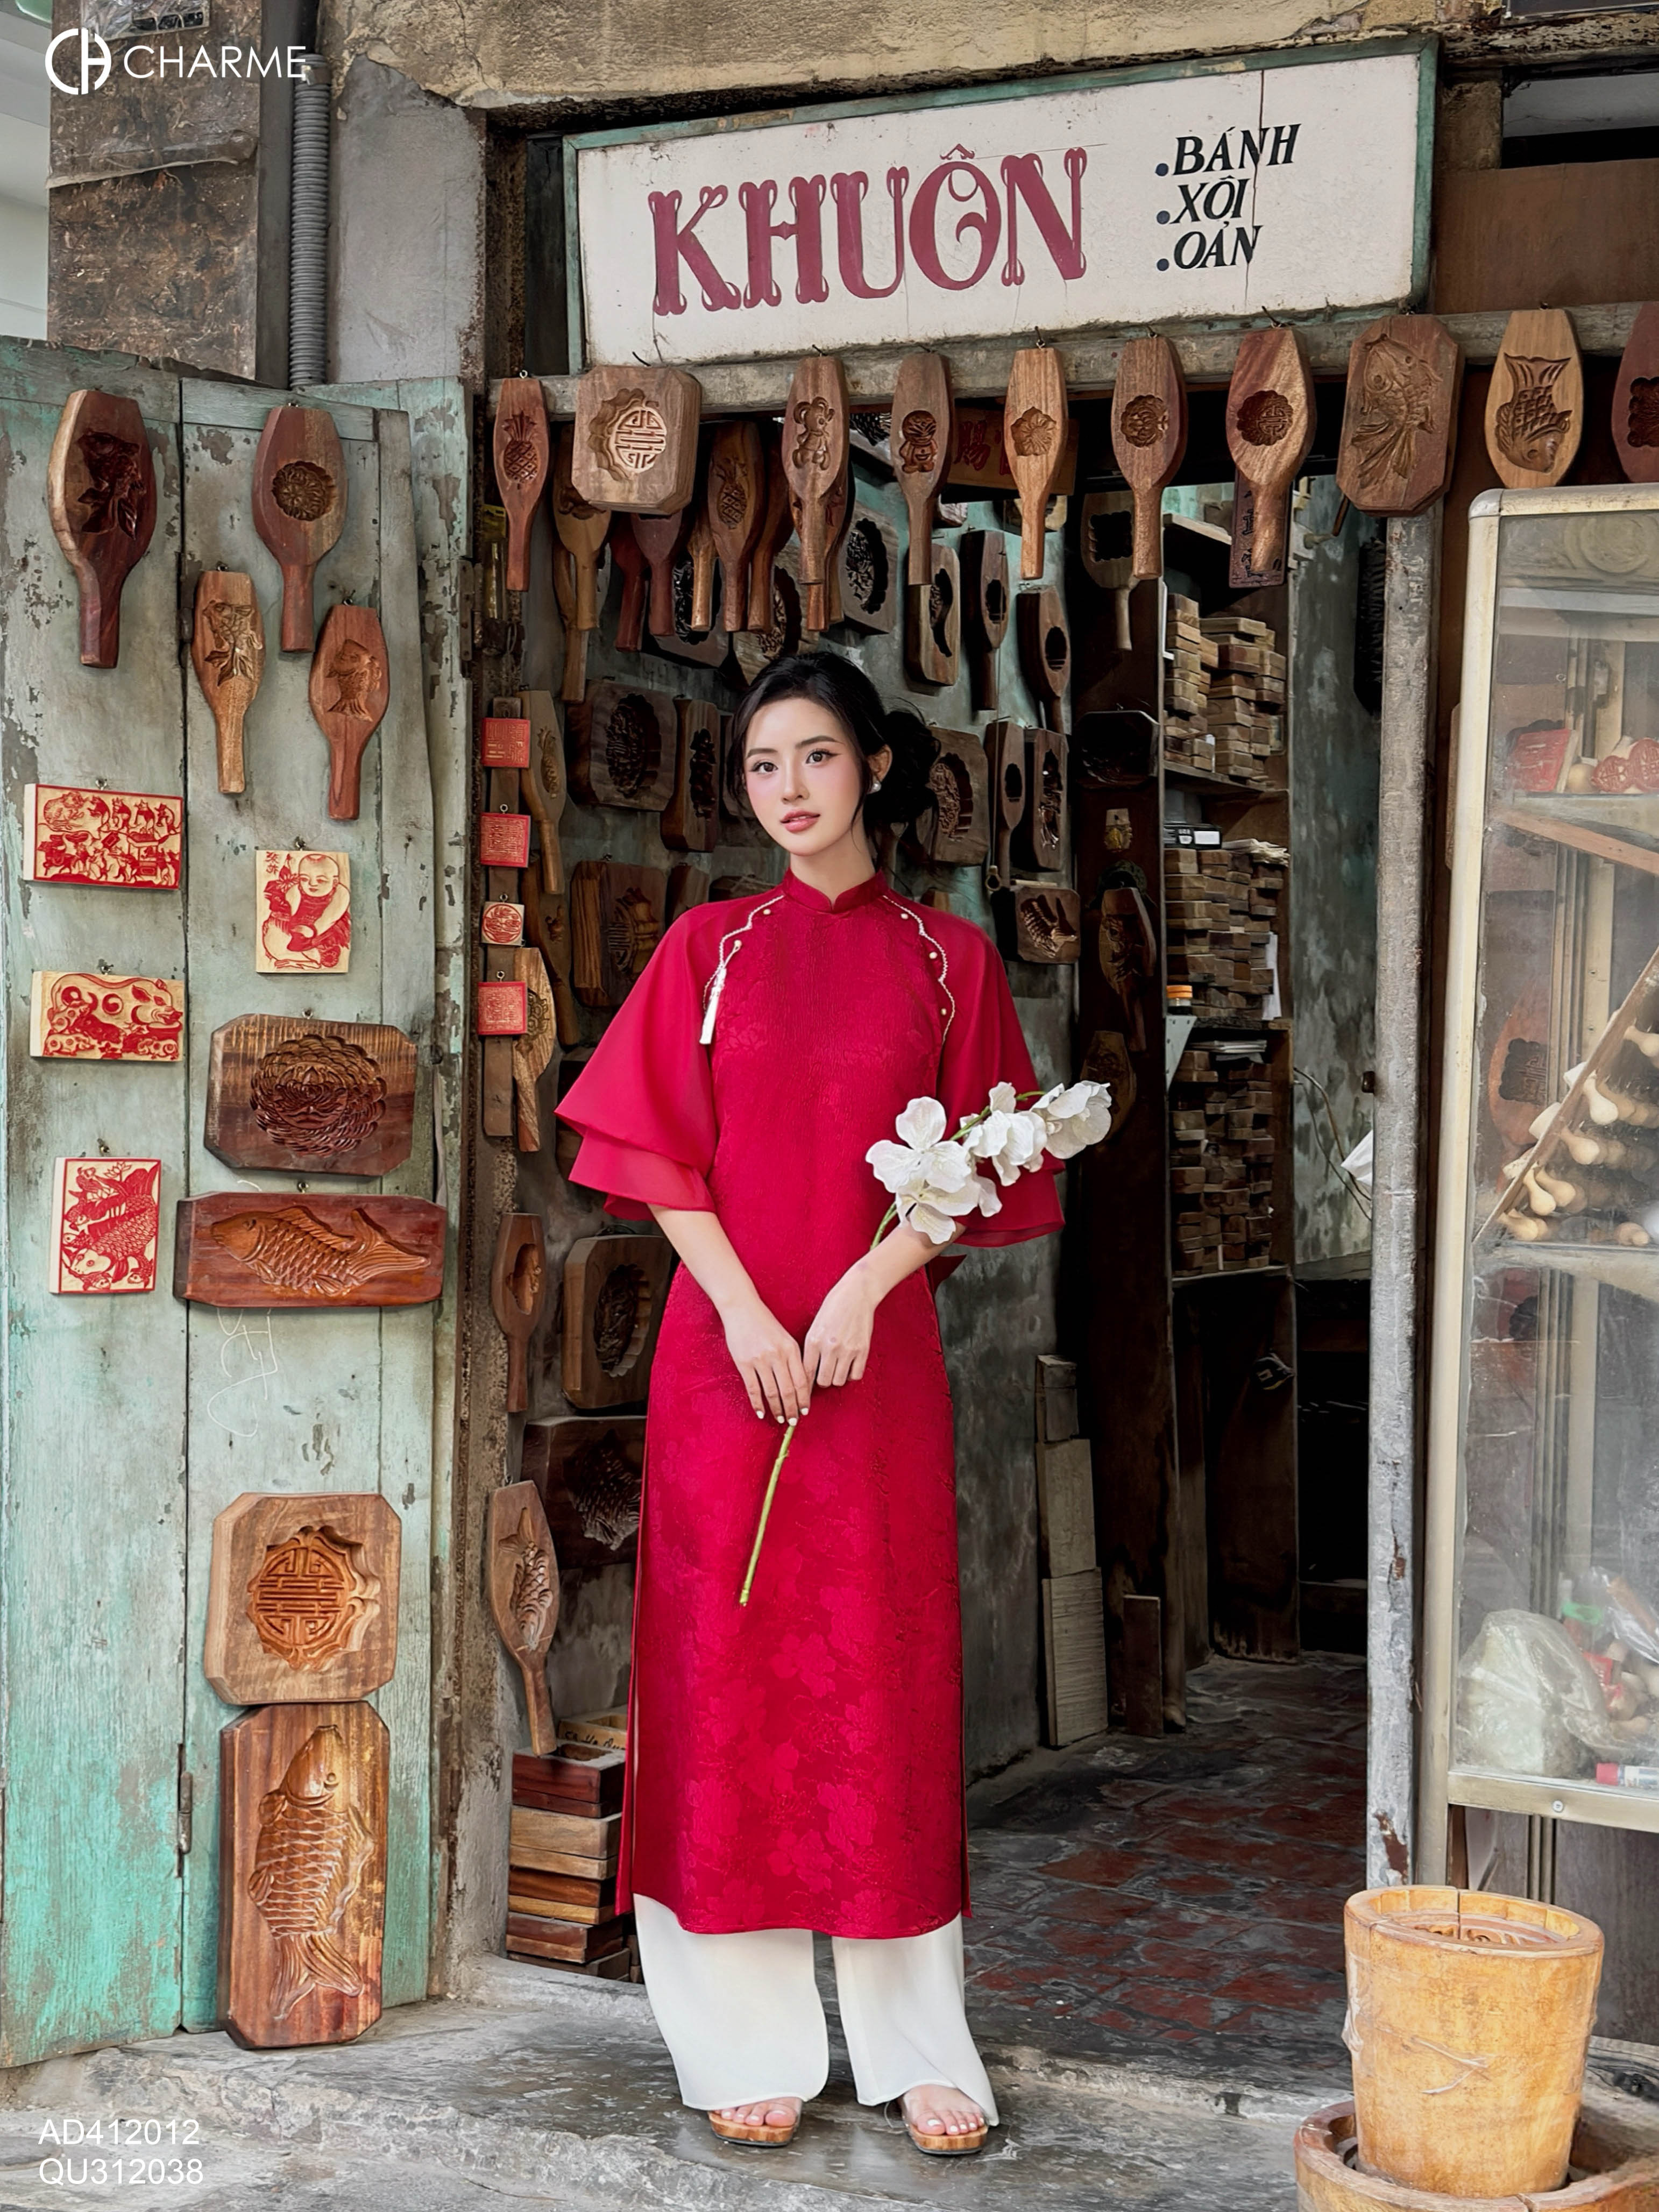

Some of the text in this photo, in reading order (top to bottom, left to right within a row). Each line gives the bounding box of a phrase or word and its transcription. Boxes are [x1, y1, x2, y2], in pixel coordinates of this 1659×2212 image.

[1172, 123, 1302, 176] BÁNH
[1169, 175, 1251, 224] XÔI
[648, 143, 1087, 316] KHUÔN
[1173, 221, 1264, 270] OẢN
